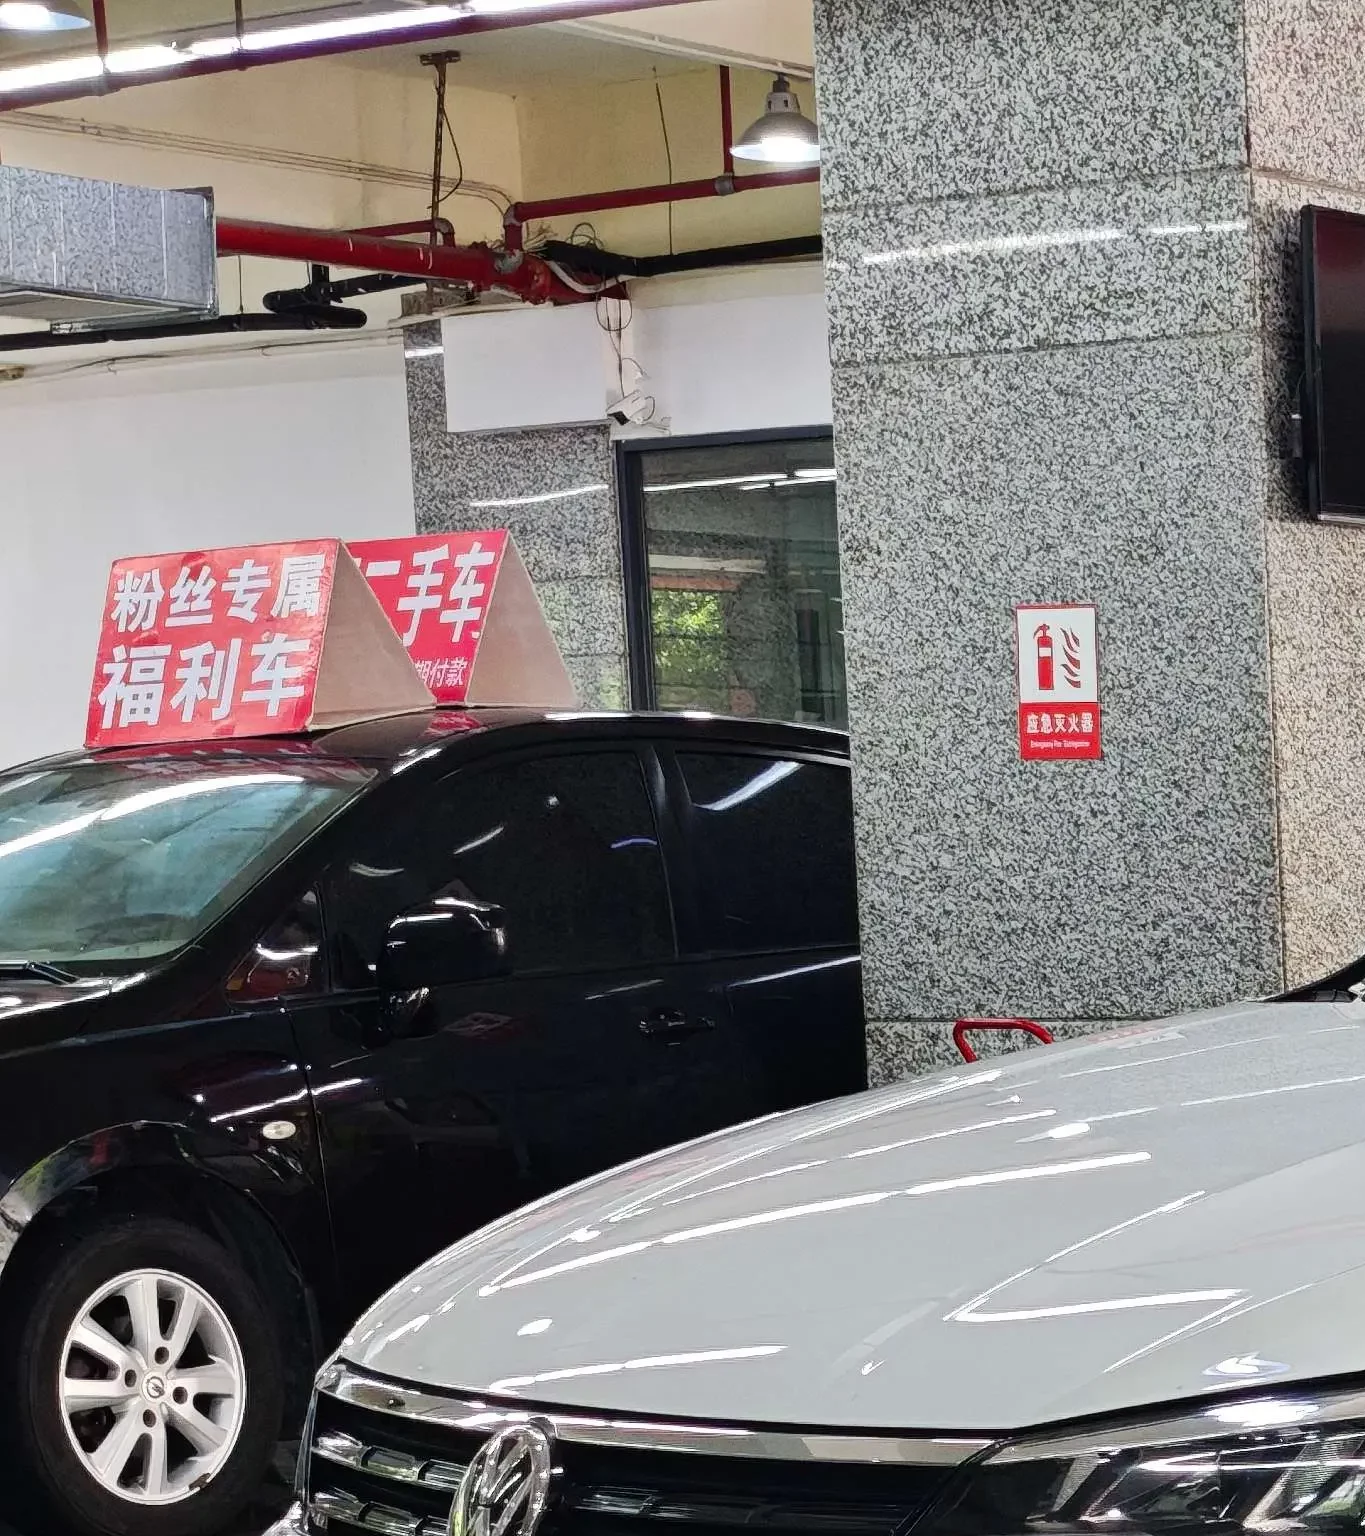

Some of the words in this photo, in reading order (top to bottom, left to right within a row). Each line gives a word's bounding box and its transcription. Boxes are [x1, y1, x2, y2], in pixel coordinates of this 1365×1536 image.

[110, 554, 326, 633] 粉丝专属
[98, 633, 311, 730] 福利车
[1026, 711, 1094, 734] 应急灭火器
